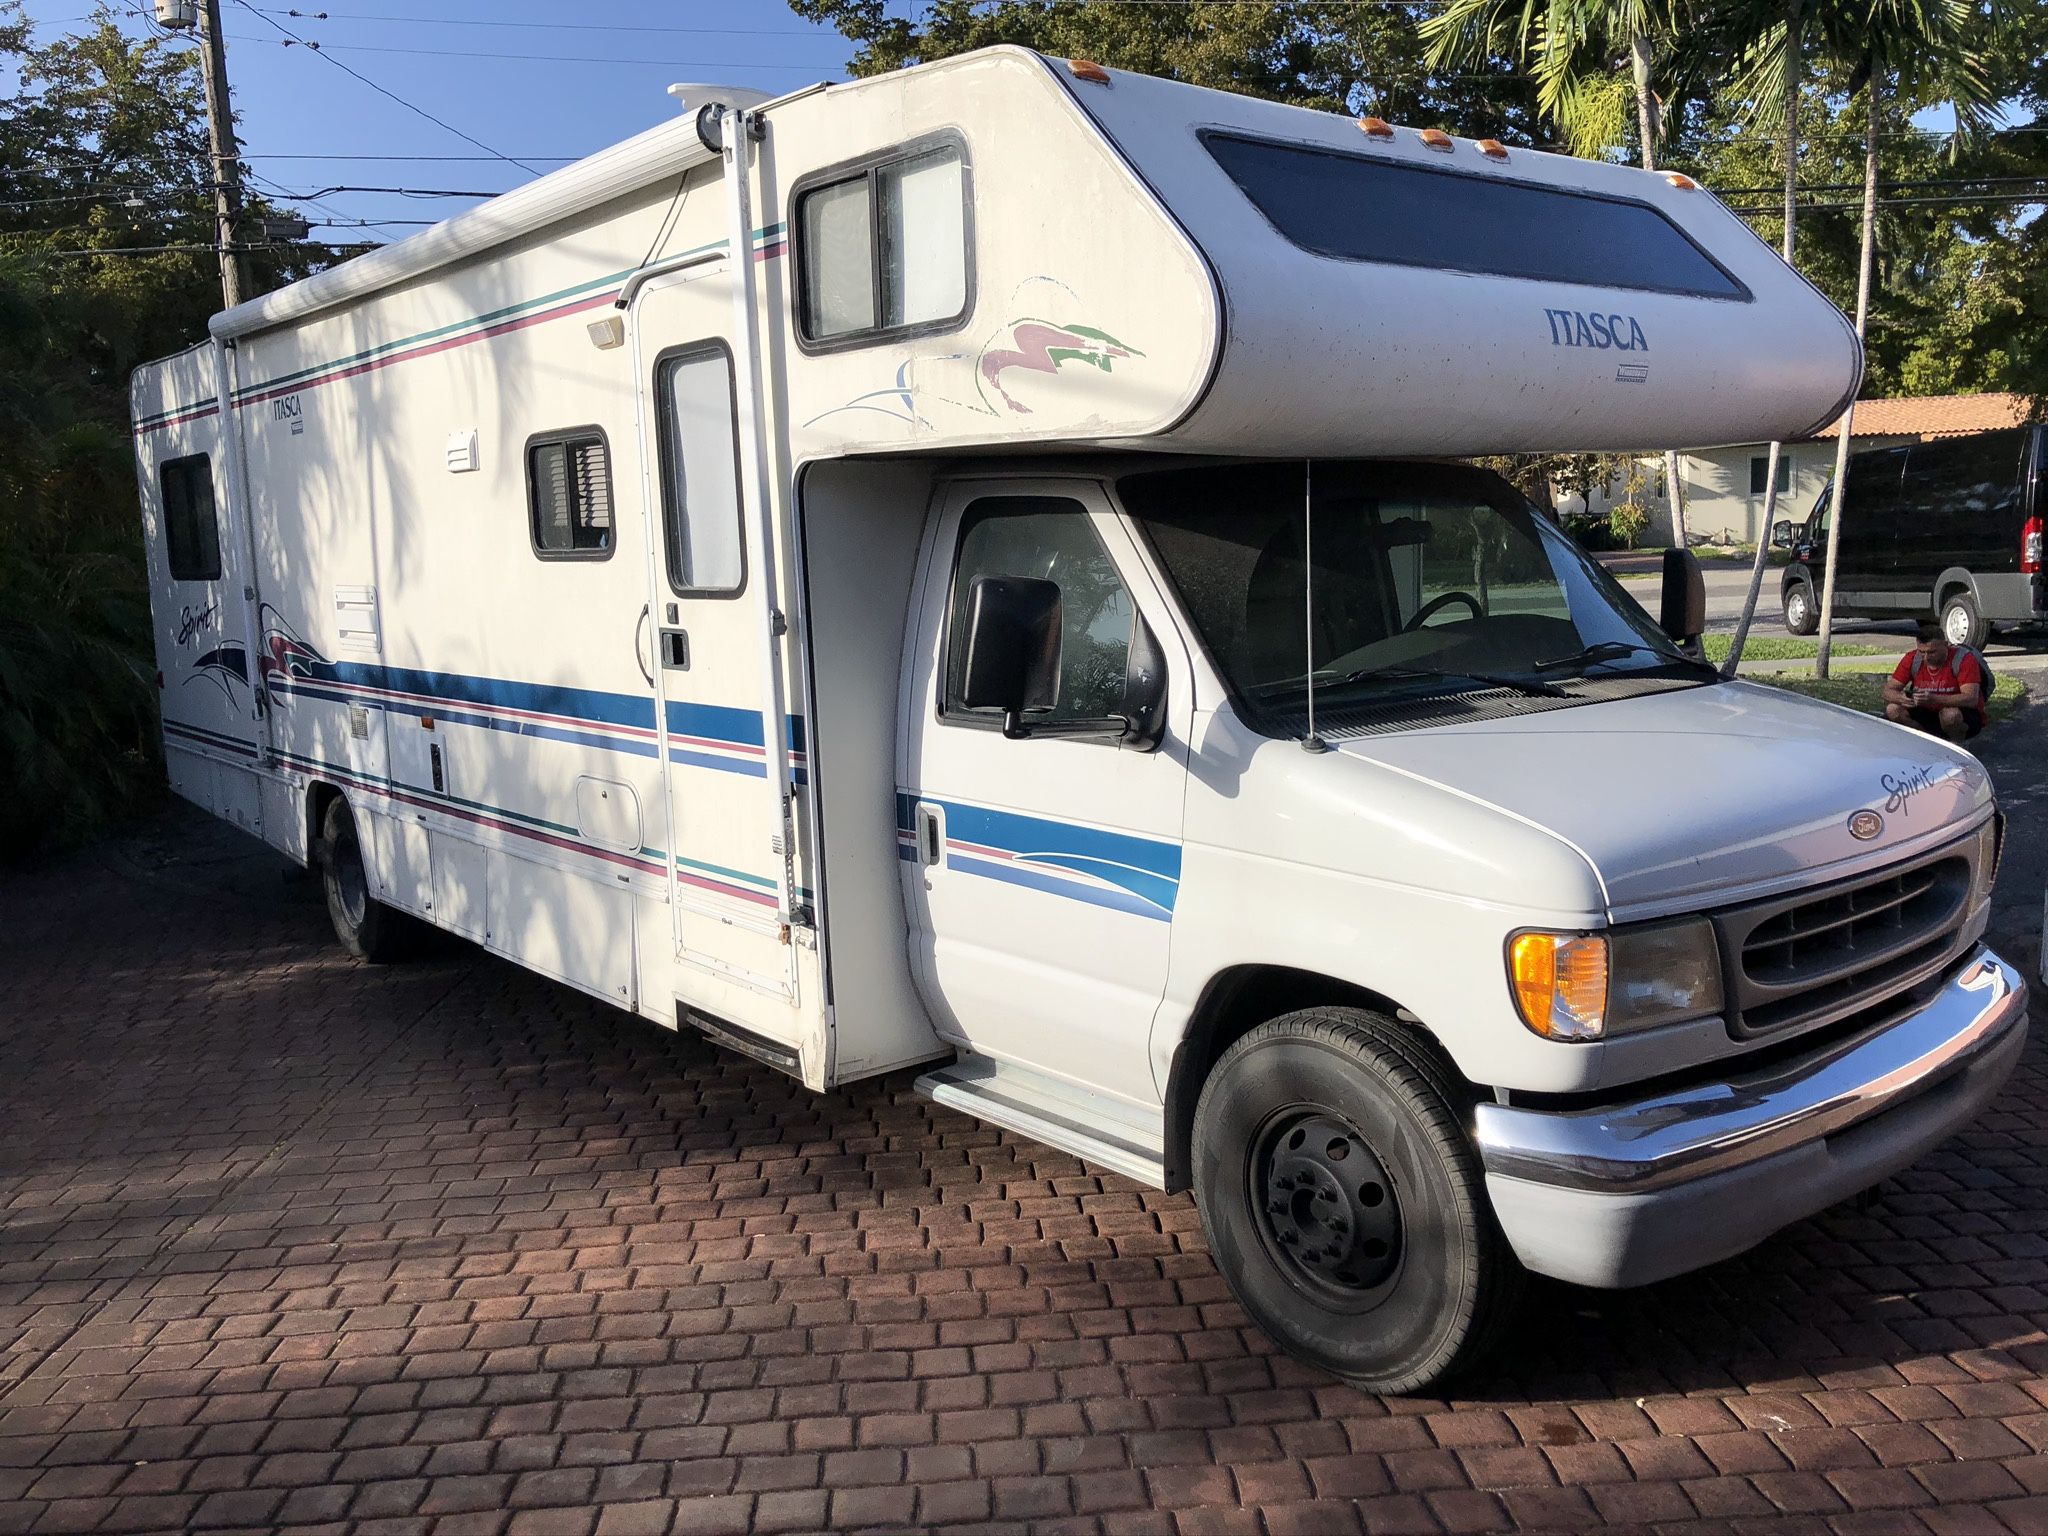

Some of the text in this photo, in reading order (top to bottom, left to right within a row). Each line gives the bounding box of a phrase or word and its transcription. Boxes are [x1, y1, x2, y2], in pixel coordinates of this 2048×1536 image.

[1543, 308, 1649, 351] ITASCA
[273, 395, 302, 421] ITASCA
[178, 601, 218, 650] Spirit
[1880, 765, 1935, 817] Spirit
